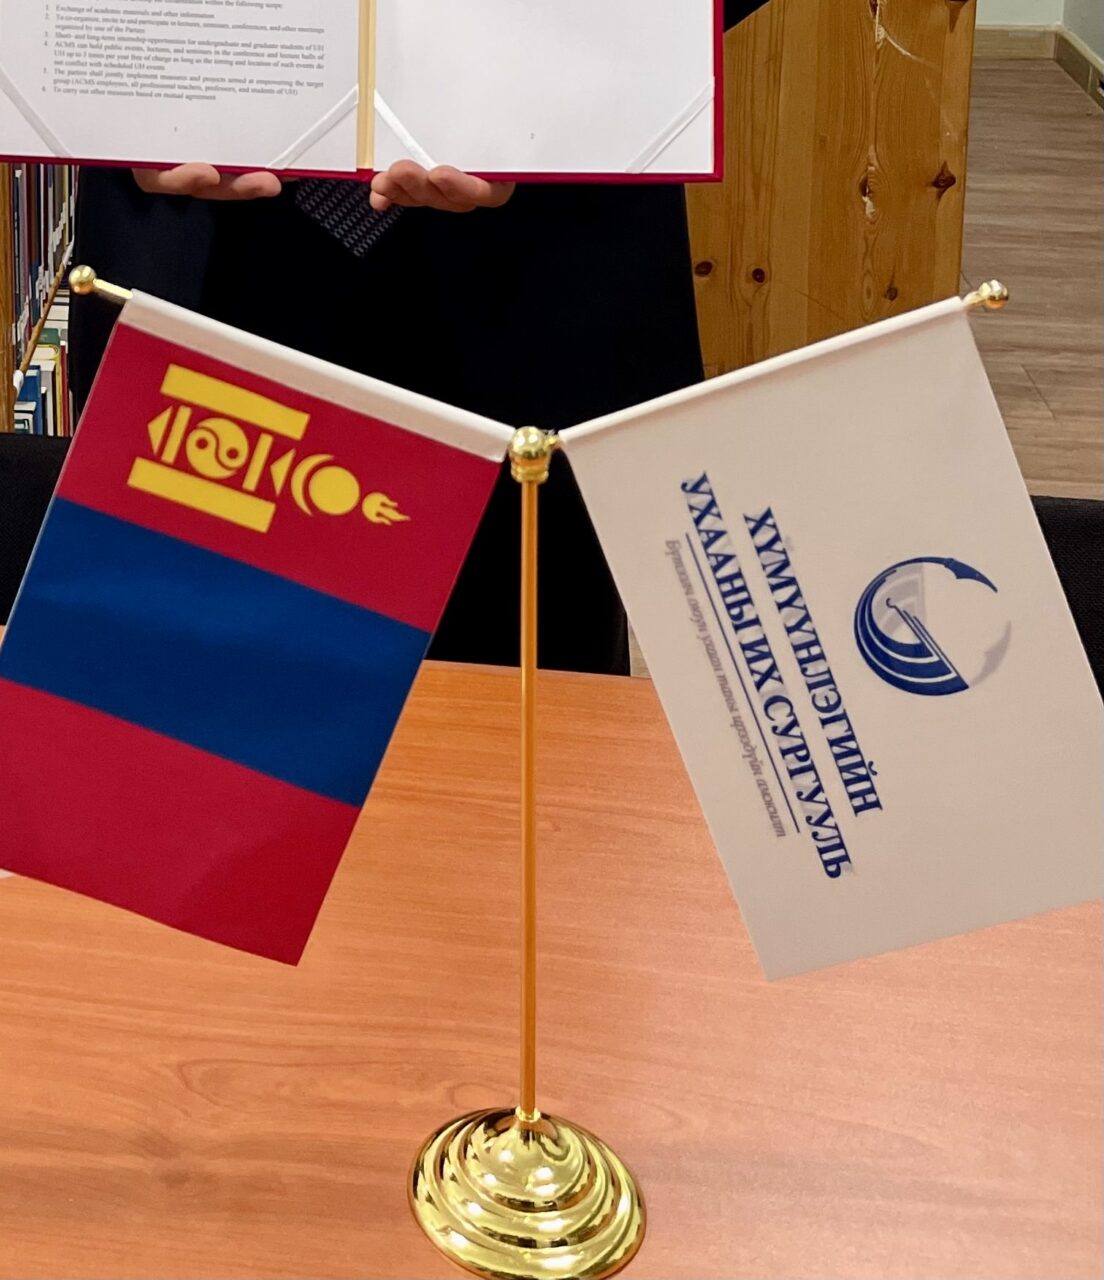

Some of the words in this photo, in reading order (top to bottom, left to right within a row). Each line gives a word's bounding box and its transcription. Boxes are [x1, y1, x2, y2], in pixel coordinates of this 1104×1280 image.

[680, 471, 763, 634] УХААНЫ
[739, 634, 784, 691] ИХ
[763, 694, 851, 879] СУРГУУЛЬ
[743, 506, 883, 817] ХҮМҮҮНЛЭГИЙН
